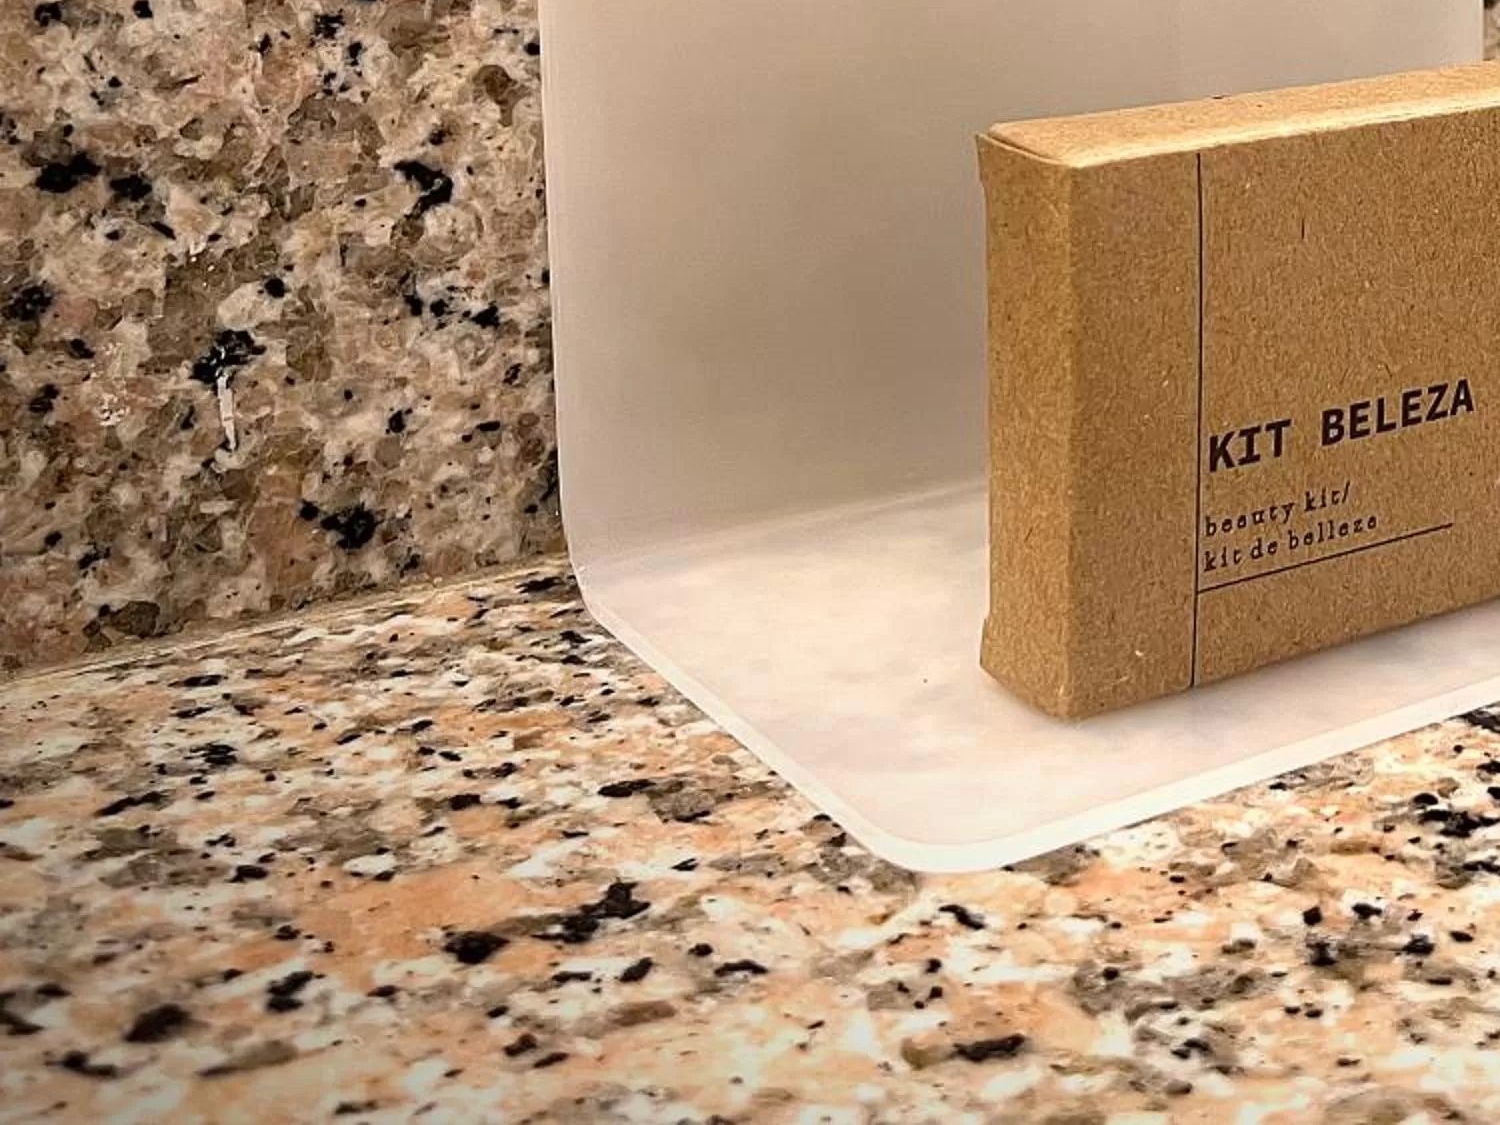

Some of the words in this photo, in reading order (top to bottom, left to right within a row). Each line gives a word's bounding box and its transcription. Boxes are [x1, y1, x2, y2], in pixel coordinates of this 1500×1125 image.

[1208, 418, 1292, 473] KIT
[1321, 378, 1475, 447] BELEZA
[1205, 502, 1295, 536] beauty
[1304, 480, 1351, 512] kit/
[1203, 546, 1243, 572] kit
[1250, 537, 1279, 560] de
[1288, 515, 1378, 550] belleza
